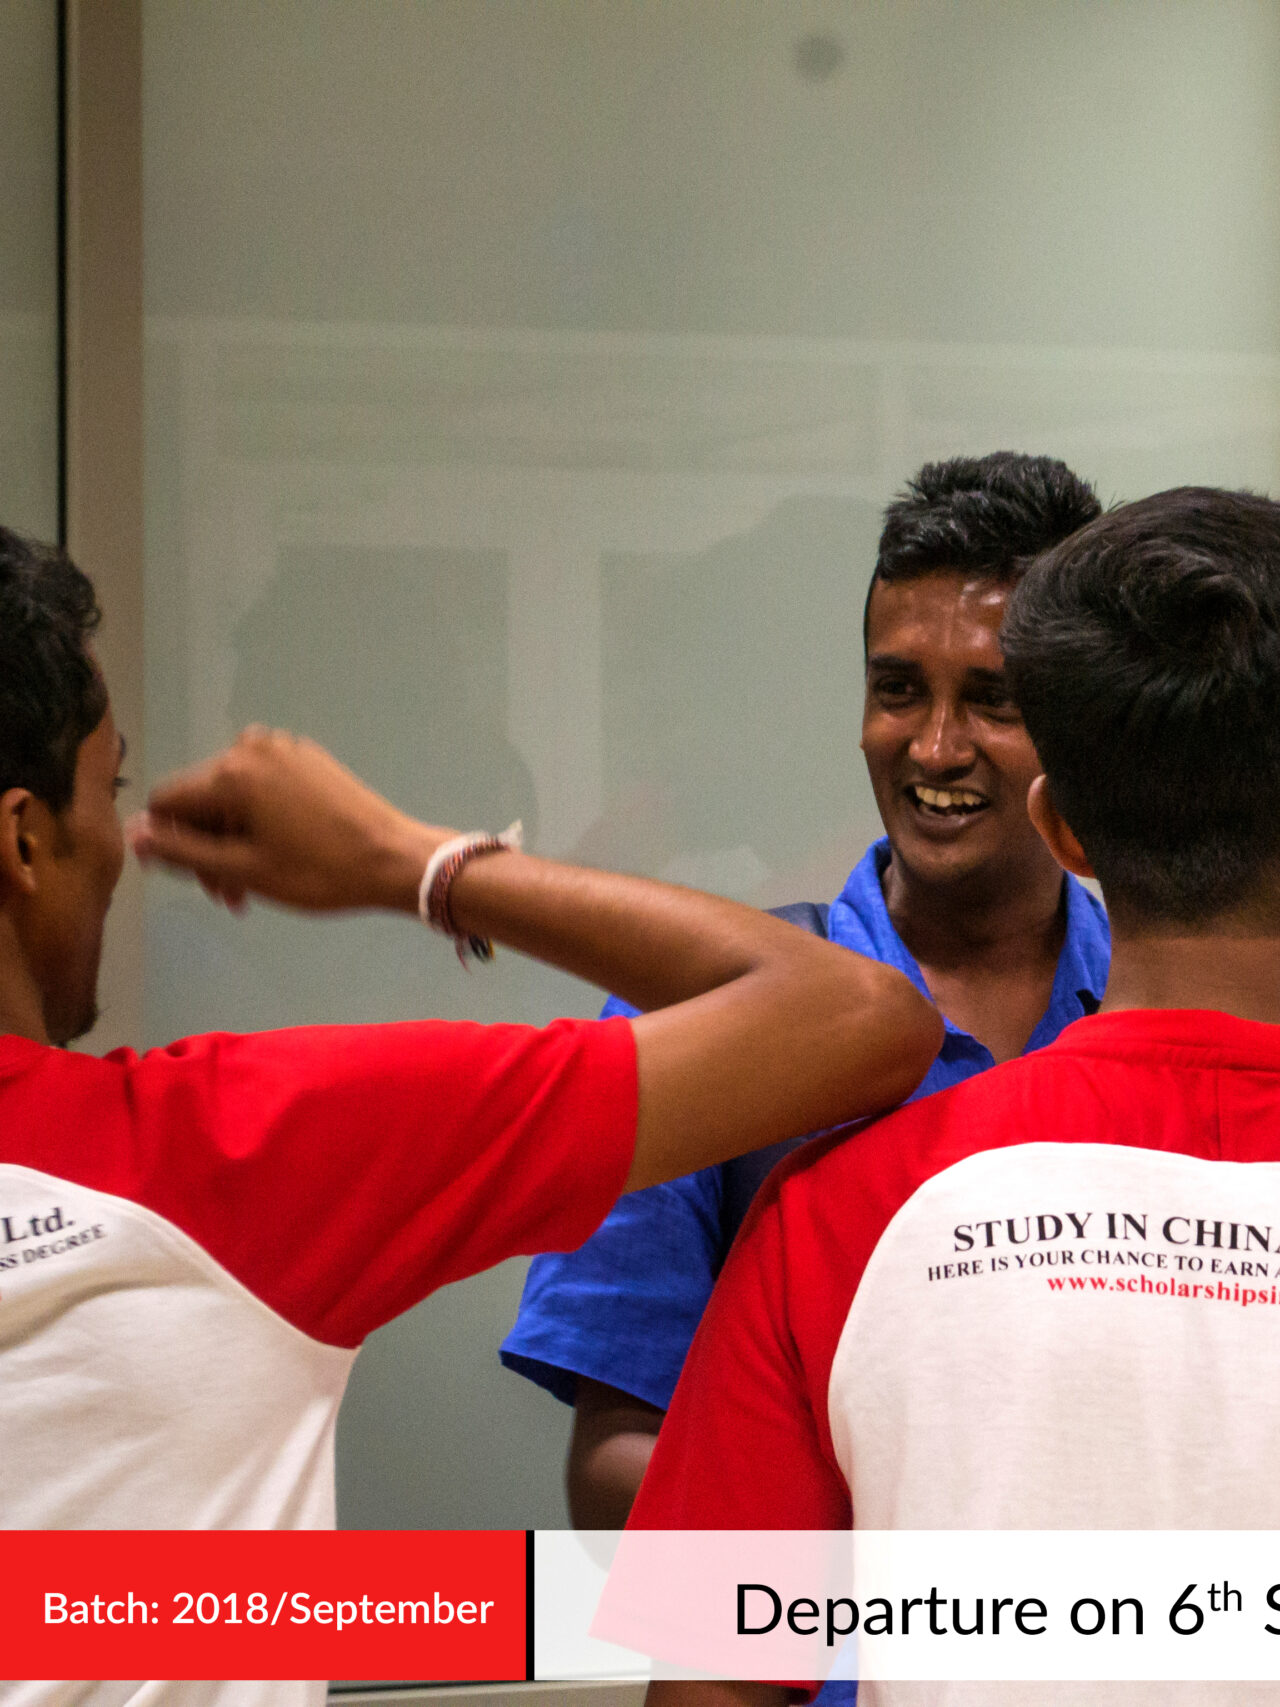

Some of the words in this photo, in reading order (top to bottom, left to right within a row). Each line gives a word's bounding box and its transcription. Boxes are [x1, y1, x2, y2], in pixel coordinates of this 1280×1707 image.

[0, 1206, 76, 1244] Ltd.
[22, 1223, 106, 1264] DEGREE
[953, 1211, 1093, 1253] STUDY
[1105, 1212, 1149, 1241] IN
[928, 1259, 984, 1282] HERE
[991, 1257, 1009, 1272] IS
[1014, 1250, 1075, 1269] YOUR
[1080, 1249, 1168, 1269] CHANCE
[1174, 1255, 1204, 1272] TO
[1211, 1258, 1269, 1278] EARN
